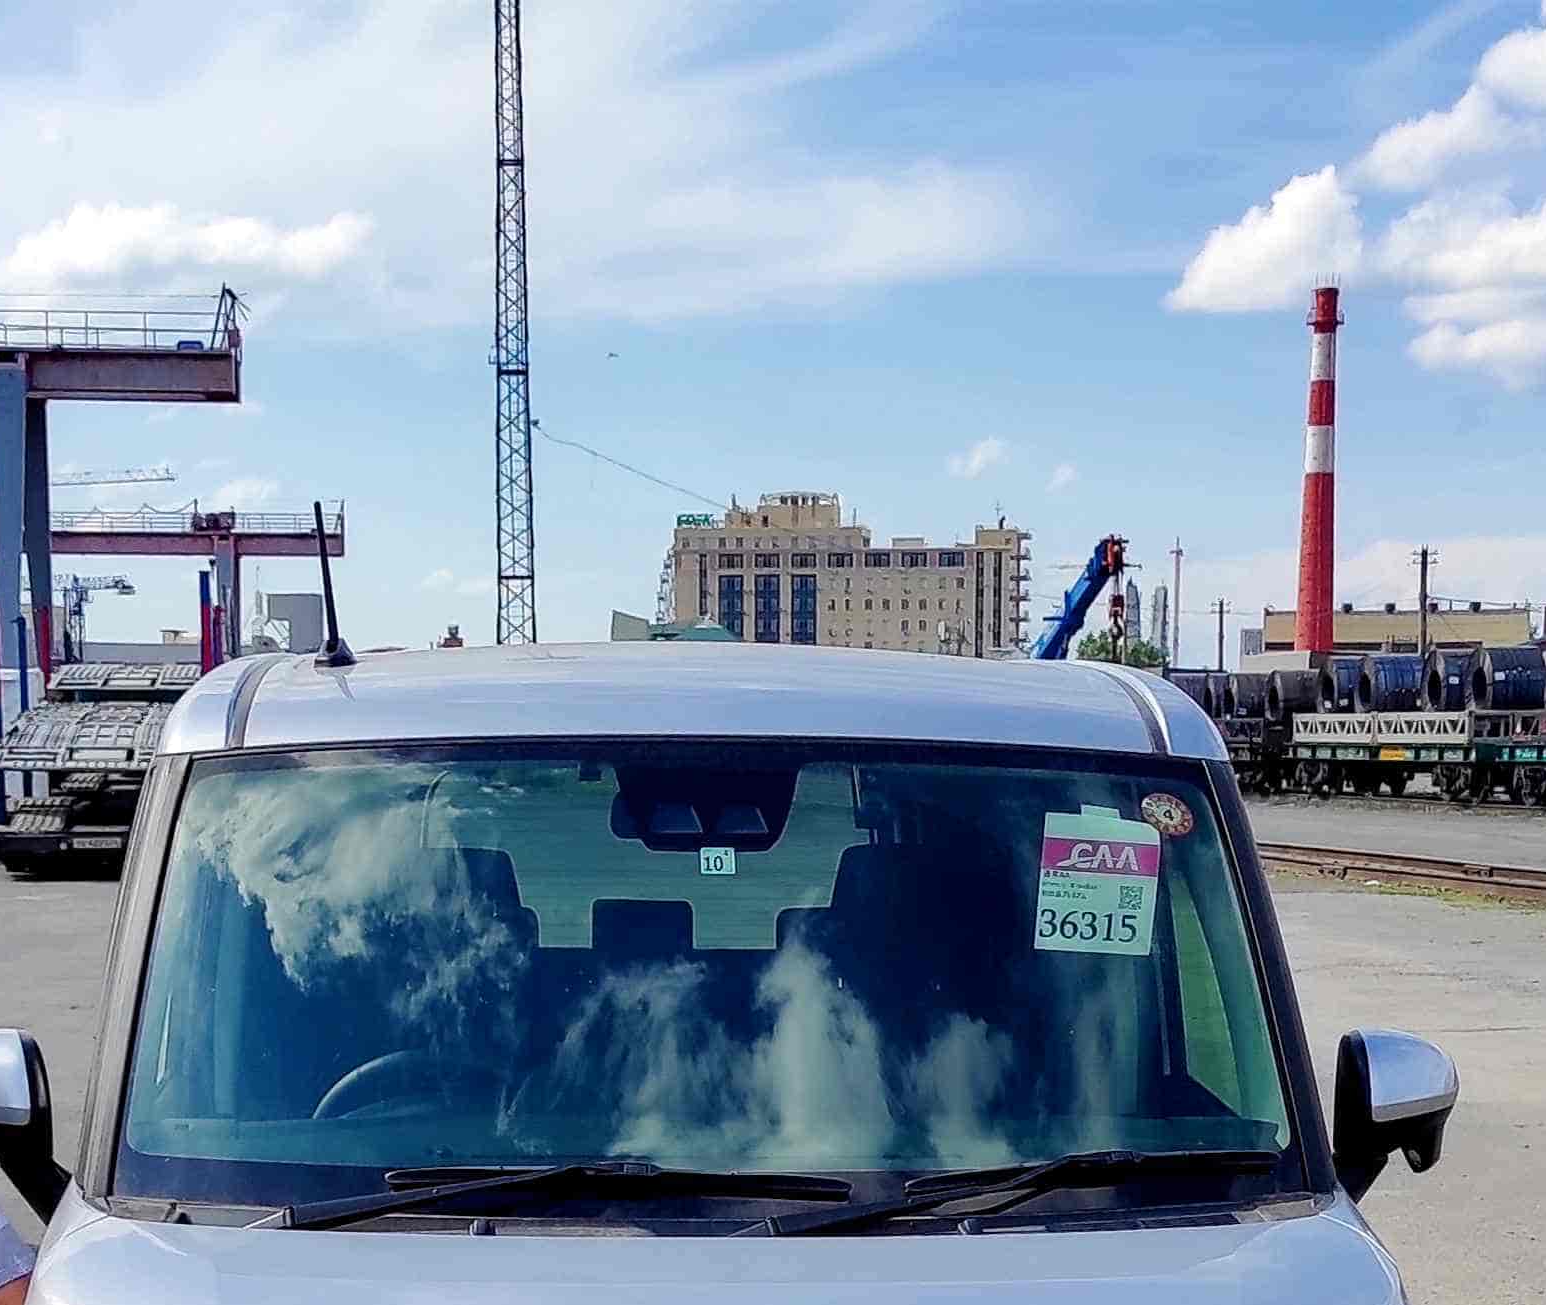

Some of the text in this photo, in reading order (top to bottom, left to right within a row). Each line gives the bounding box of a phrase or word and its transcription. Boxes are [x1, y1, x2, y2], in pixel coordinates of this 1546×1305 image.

[703, 855, 723, 871] 10
[1055, 842, 1139, 872] CAA
[1039, 908, 1138, 943] 36315
